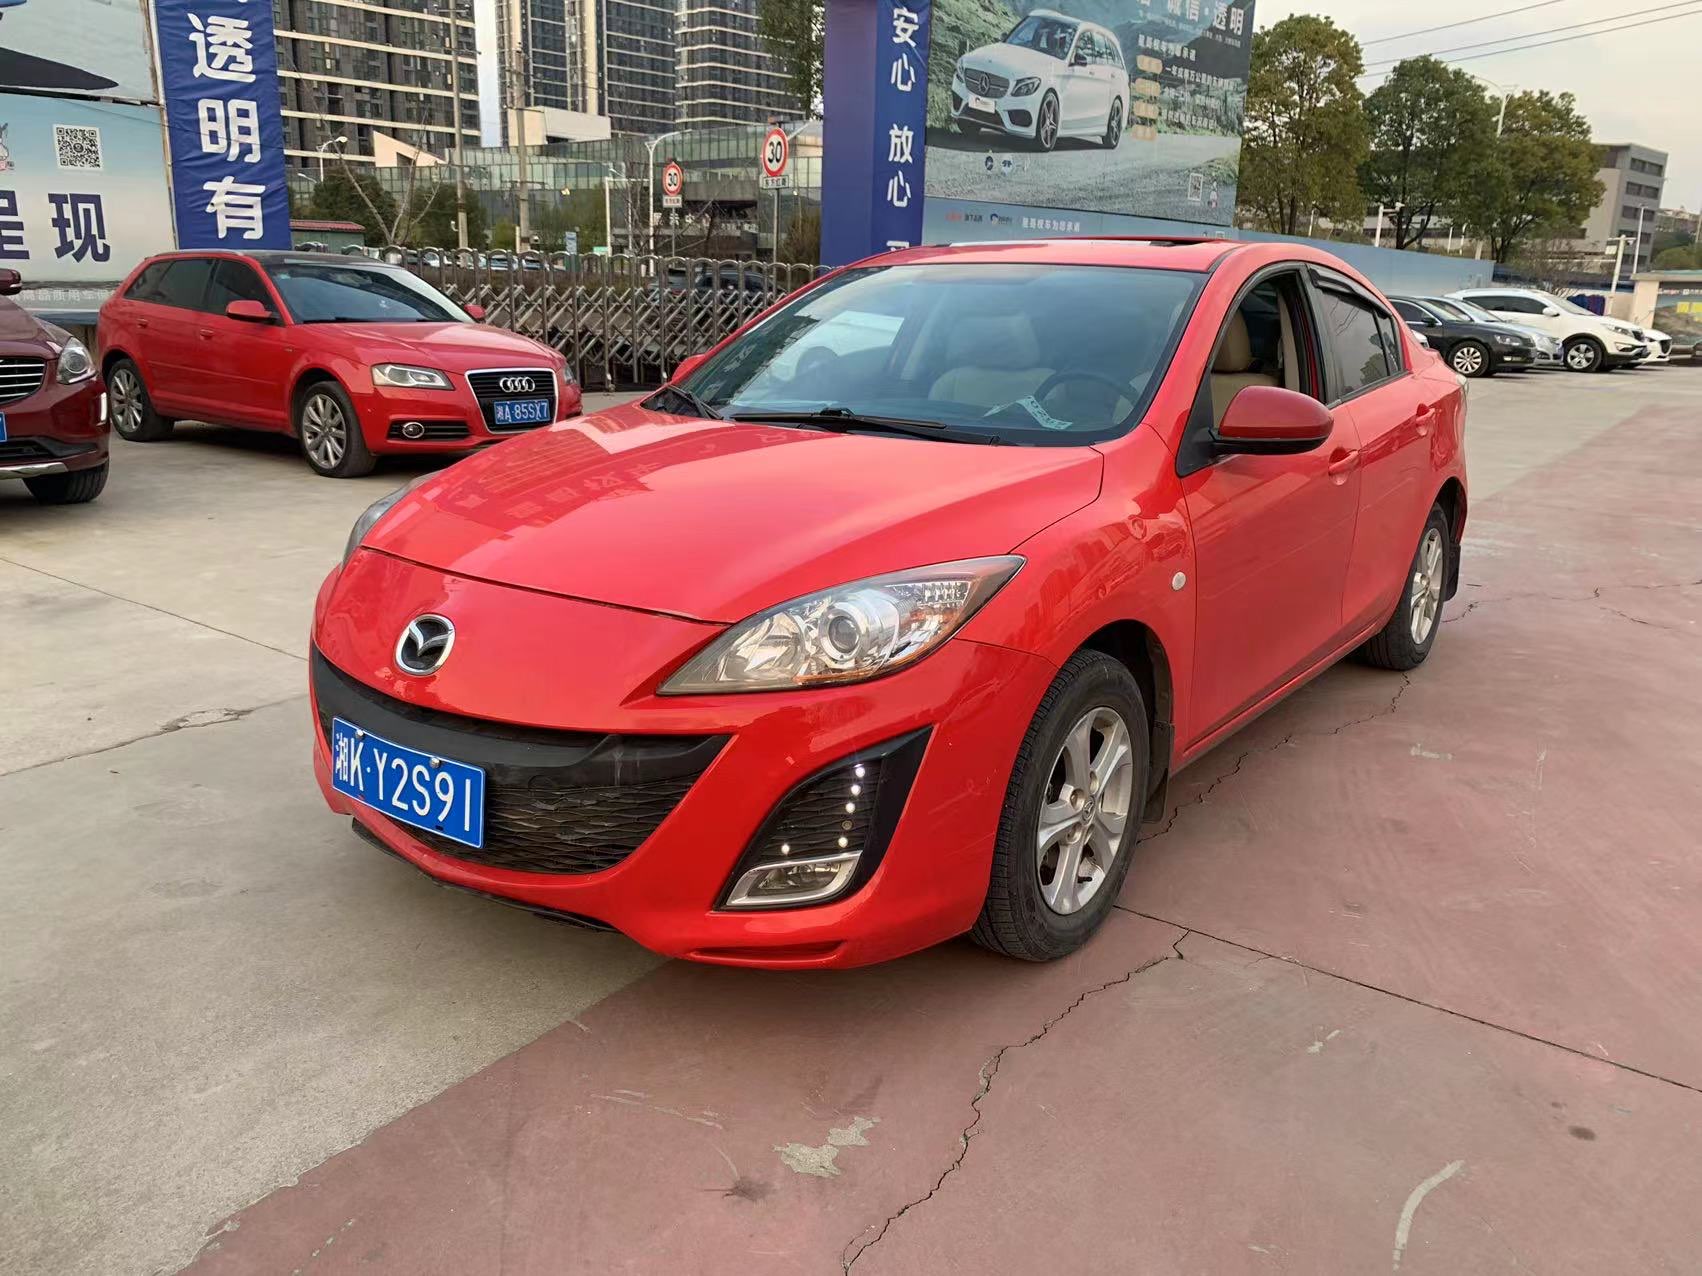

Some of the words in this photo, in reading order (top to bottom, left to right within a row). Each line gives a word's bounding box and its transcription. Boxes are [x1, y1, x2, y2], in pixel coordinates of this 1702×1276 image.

[891, 7, 919, 92] 安心
[187, 12, 267, 241] 透明有
[767, 140, 783, 164] 30
[886, 123, 914, 208] 放心
[668, 172, 678, 187] 30
[334, 732, 472, 832] 湘K·Y2S91
